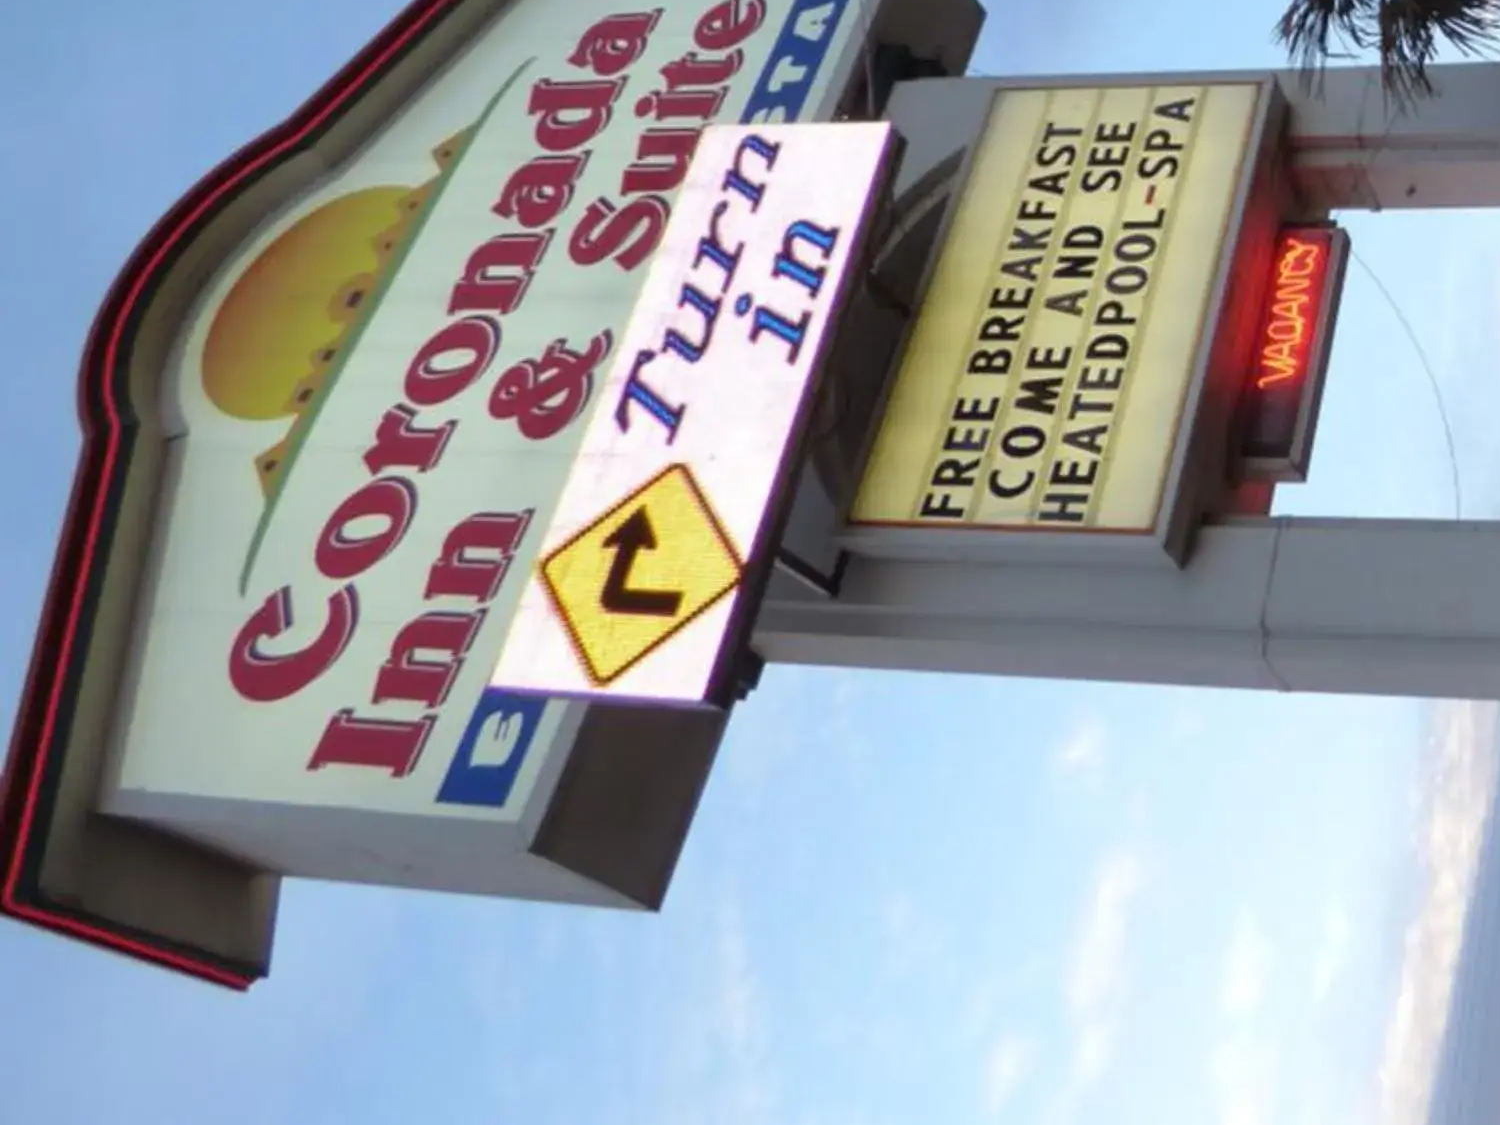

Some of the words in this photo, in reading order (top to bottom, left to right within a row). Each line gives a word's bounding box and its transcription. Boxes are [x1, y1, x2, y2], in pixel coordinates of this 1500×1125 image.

[228, 7, 667, 704] Coronada
[615, 133, 781, 446] Turn
[736, 216, 840, 367] in
[920, 396, 1000, 520] FREE
[967, 121, 1083, 376] BREAKFAST
[987, 345, 1074, 500] COME
[1047, 223, 1106, 318] AND
[1081, 120, 1136, 193] SEE
[1257, 236, 1320, 390] VACANCY
[306, 507, 534, 778] Inn
[488, 328, 613, 441] &
